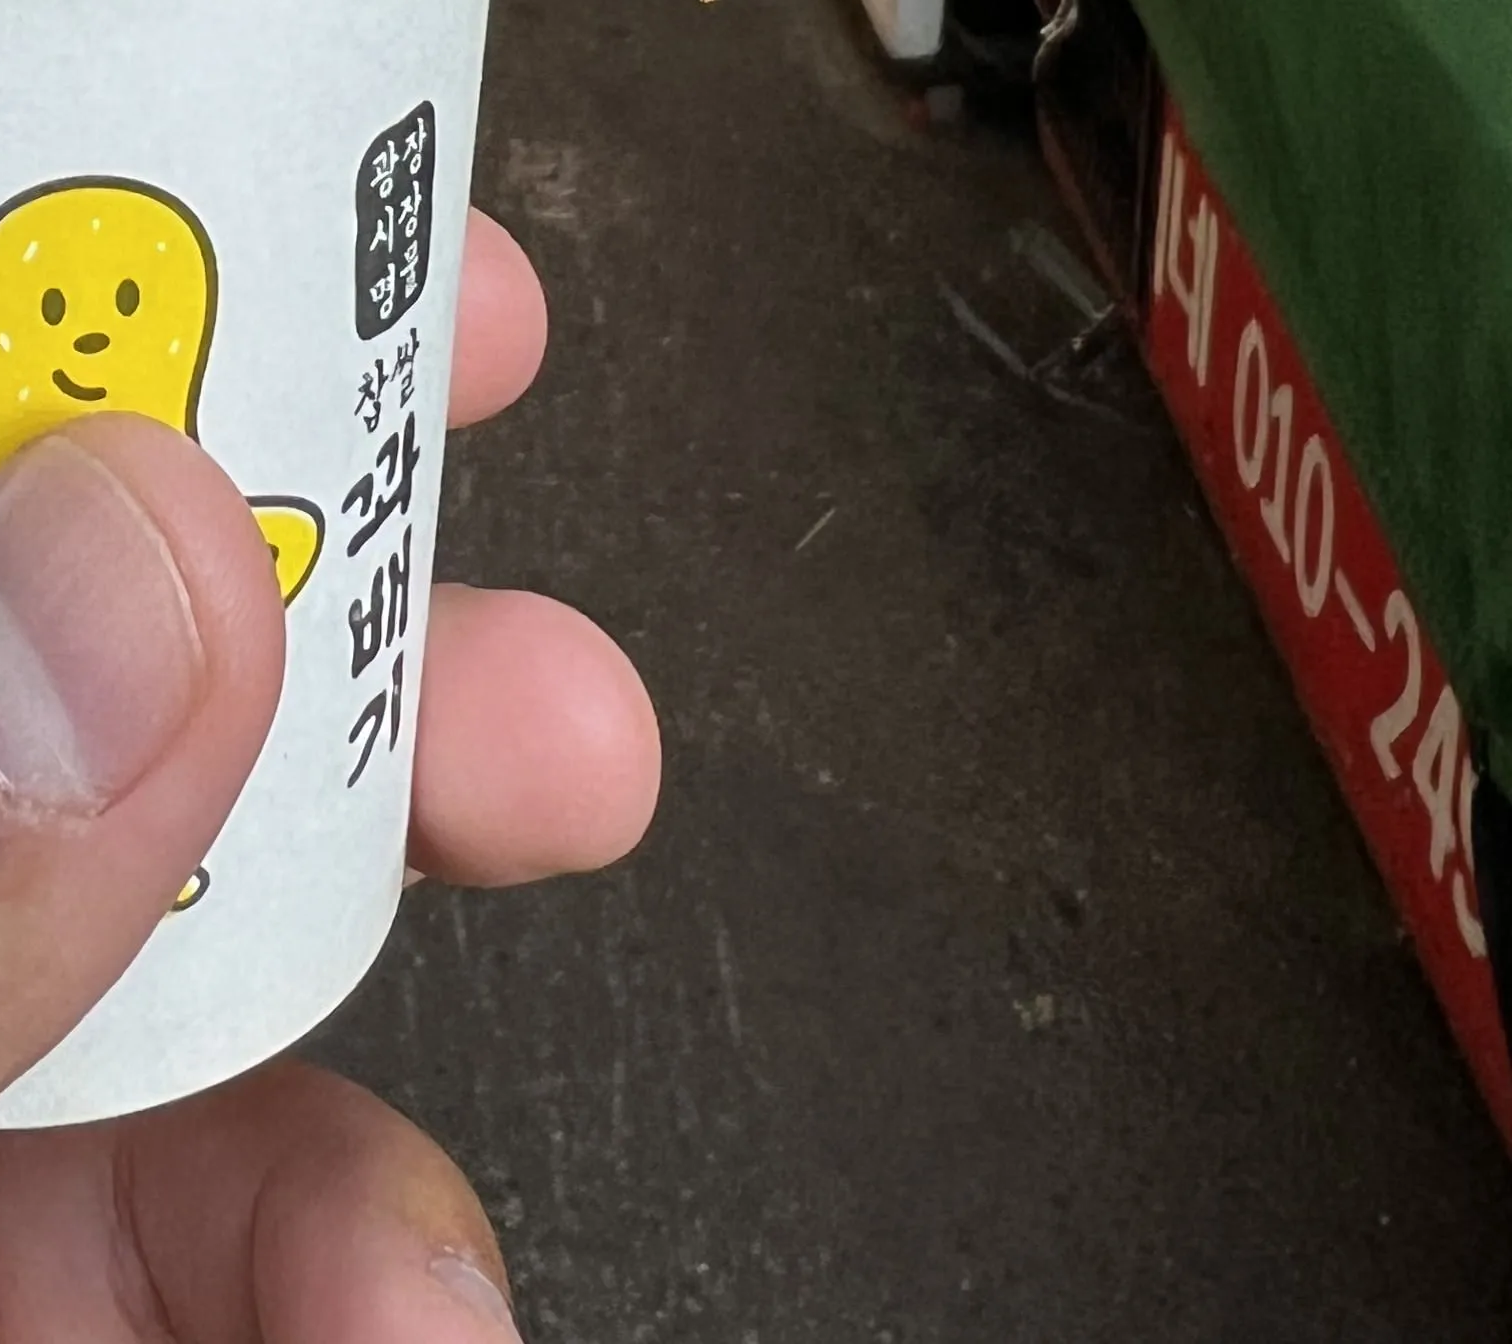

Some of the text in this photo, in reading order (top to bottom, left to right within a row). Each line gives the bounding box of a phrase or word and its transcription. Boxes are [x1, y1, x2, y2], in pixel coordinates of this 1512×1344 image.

[369, 117, 428, 193] 광장
[369, 181, 424, 253] 시장
[370, 241, 421, 320] 명물
[354, 327, 420, 434] 찹쌀
[341, 412, 421, 790] 꽈배기
